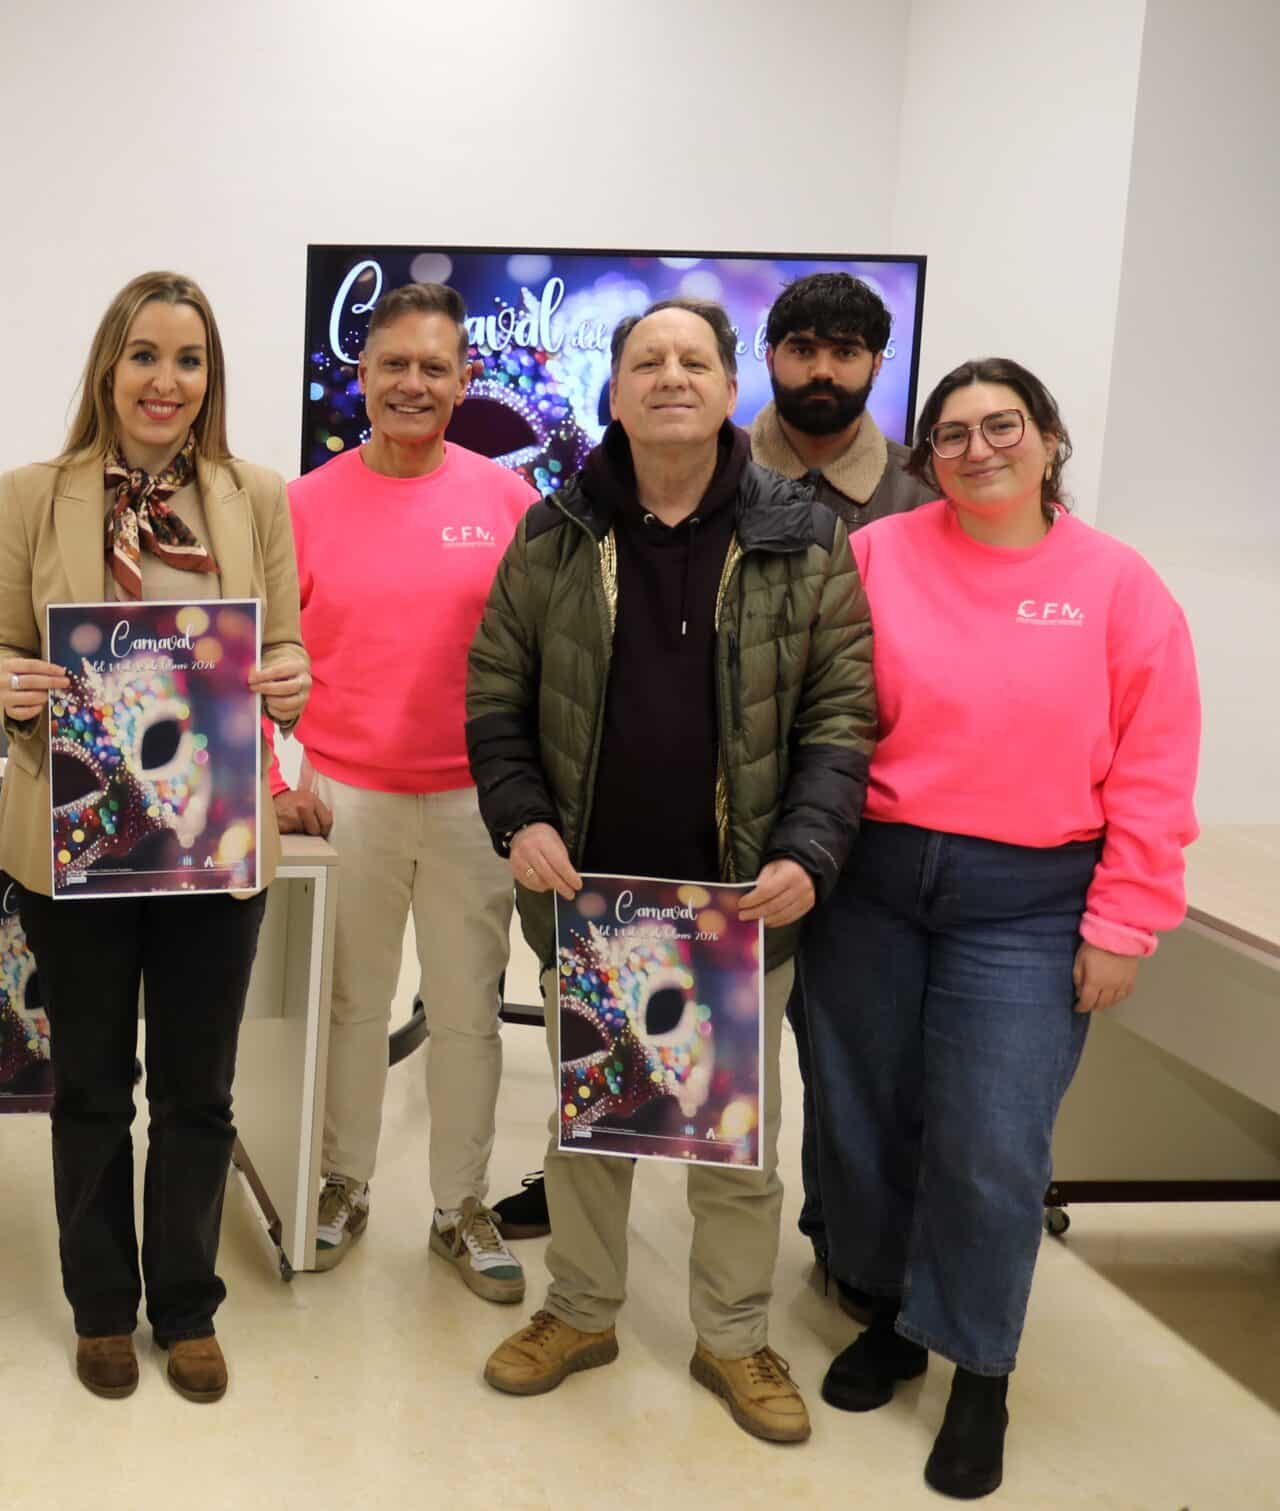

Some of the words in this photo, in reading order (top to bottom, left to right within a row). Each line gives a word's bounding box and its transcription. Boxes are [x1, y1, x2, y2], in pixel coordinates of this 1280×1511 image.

[329, 260, 565, 364] Caval
[111, 620, 195, 658] Carnaval
[615, 889, 698, 924] Carnaval
